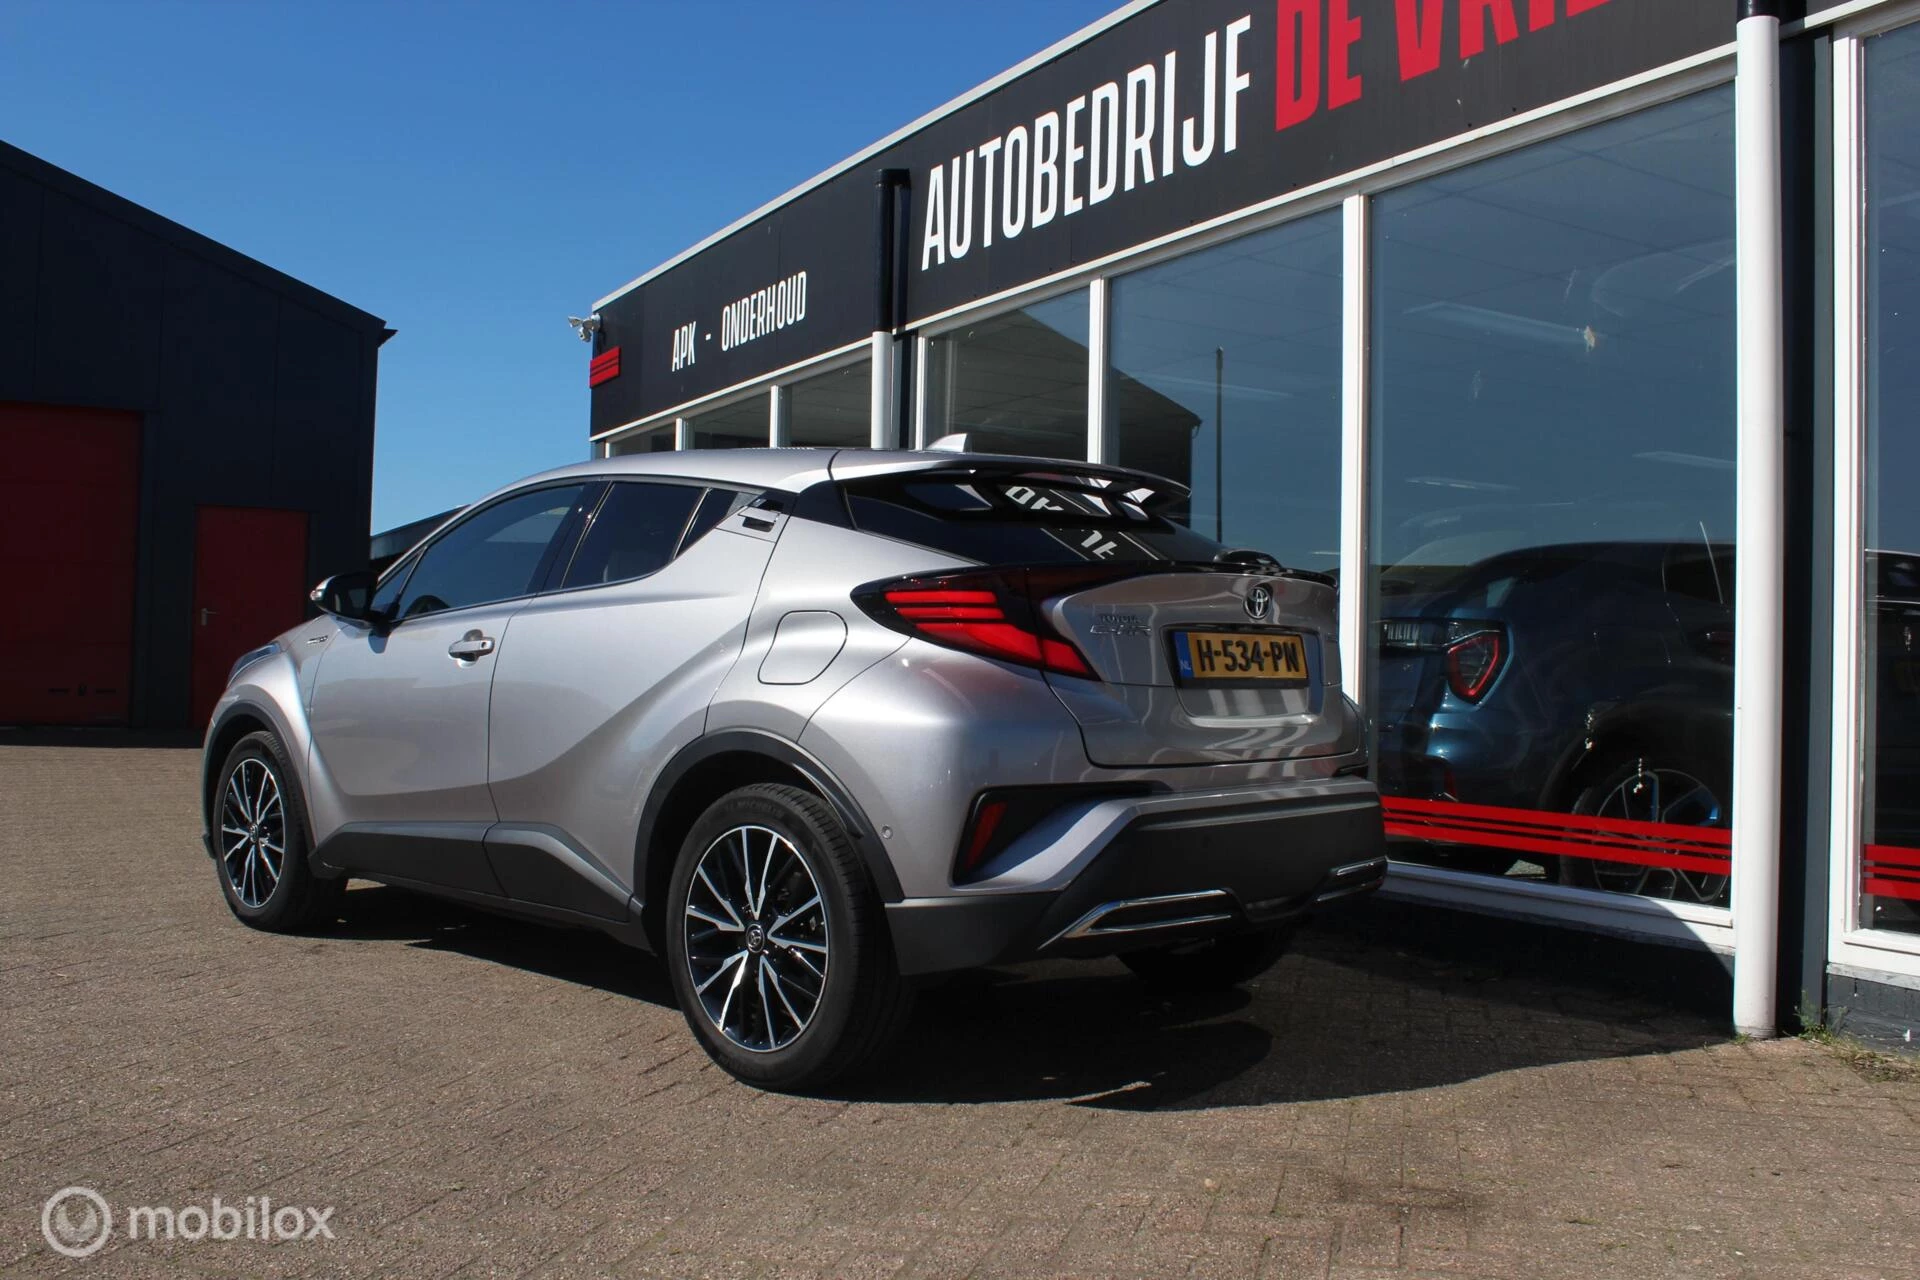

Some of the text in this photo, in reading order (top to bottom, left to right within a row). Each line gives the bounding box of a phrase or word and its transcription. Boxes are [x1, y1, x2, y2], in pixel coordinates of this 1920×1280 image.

[921, 14, 1251, 271] AUTOBEDRIJF
[1275, 0, 1362, 132] DE
[672, 321, 697, 372] APK
[721, 271, 807, 351] ONDERHOUD
[1197, 639, 1300, 673] H-534-PN
